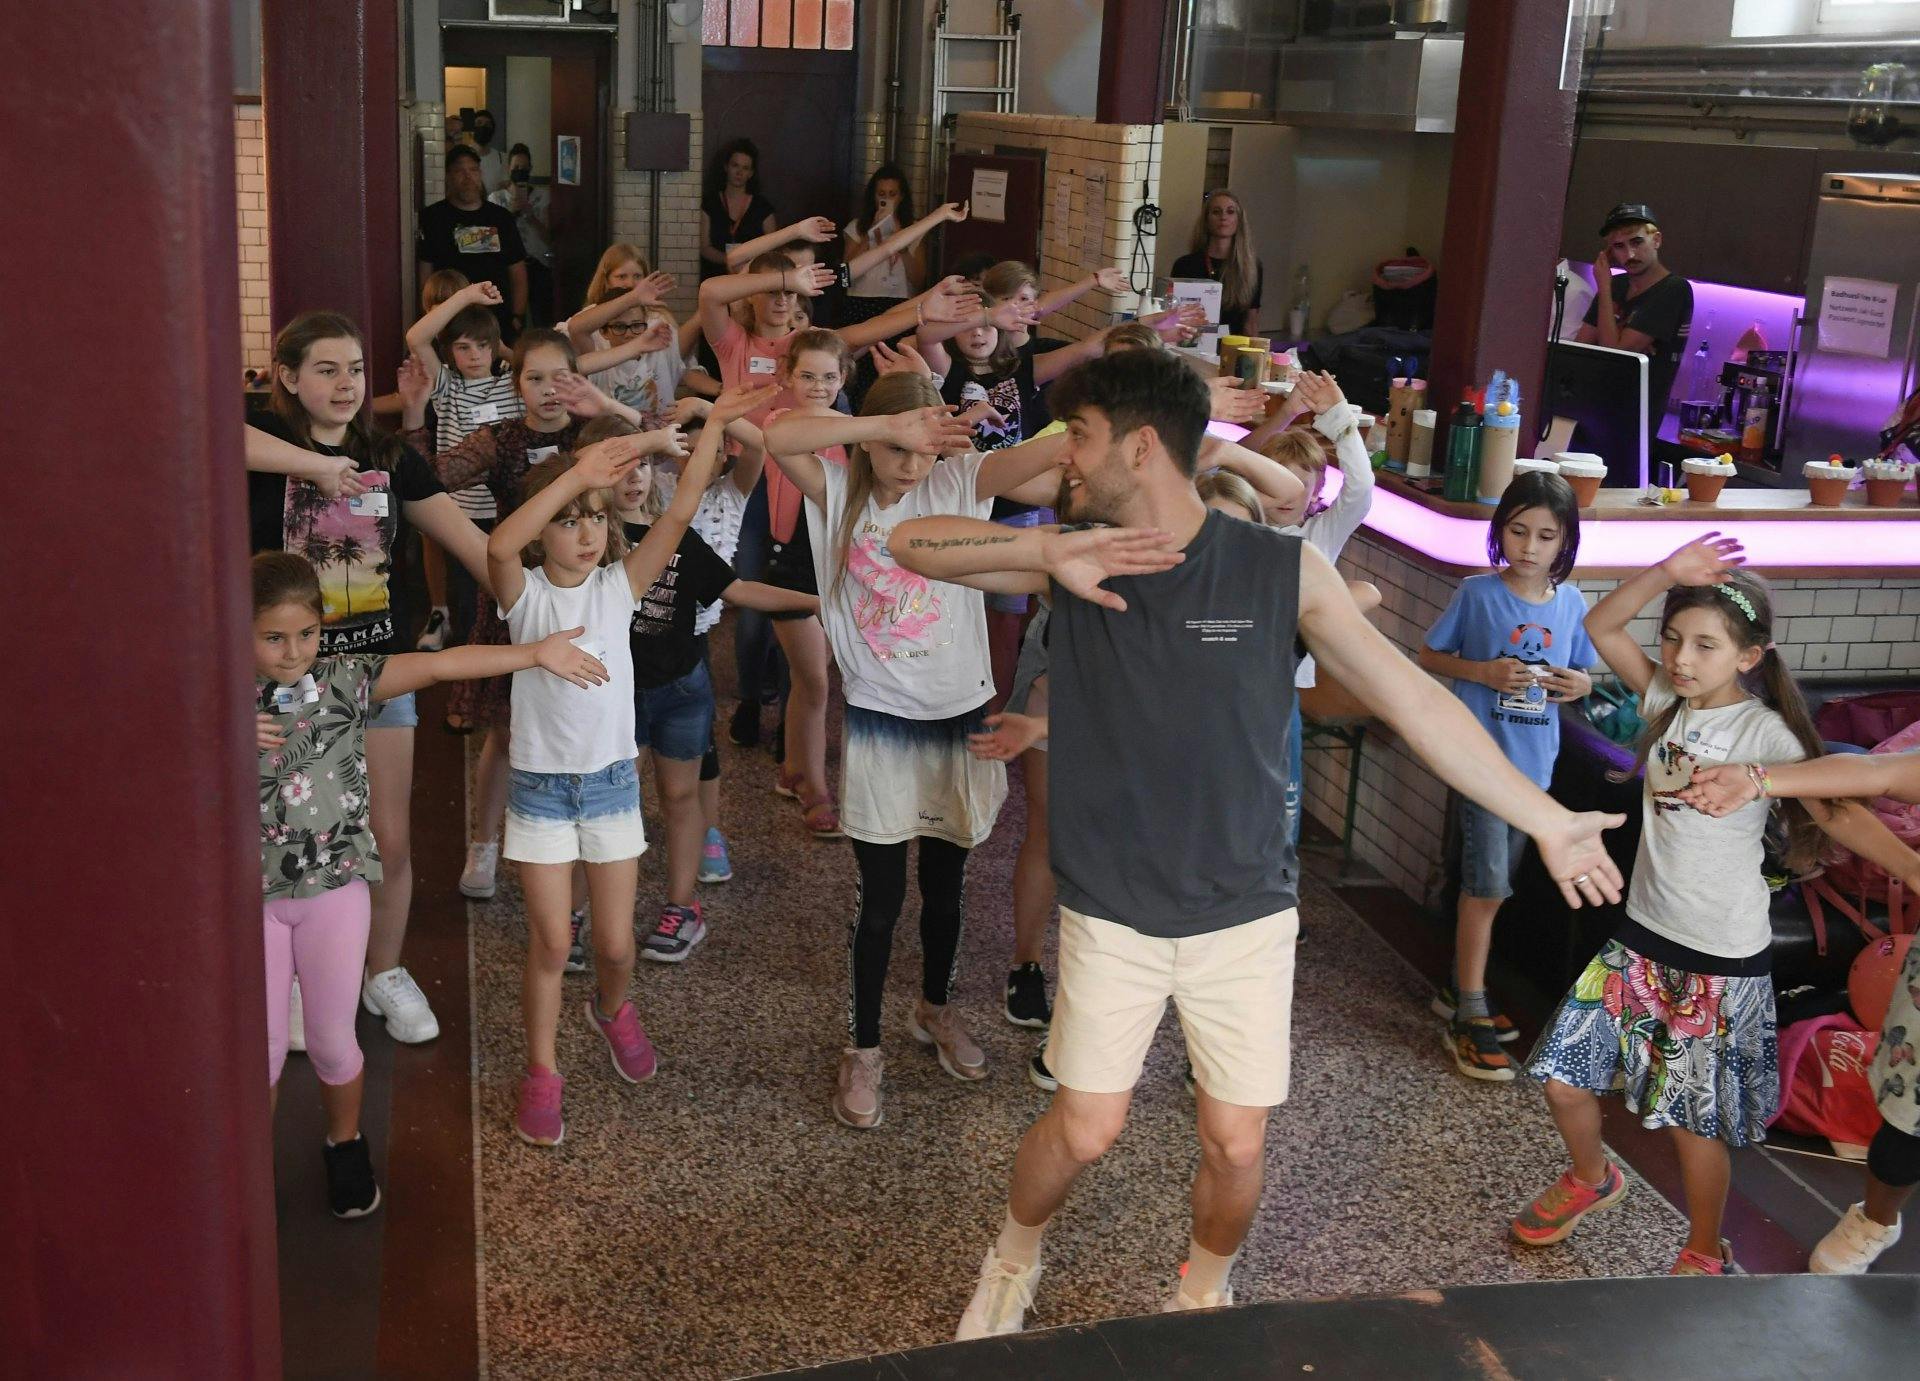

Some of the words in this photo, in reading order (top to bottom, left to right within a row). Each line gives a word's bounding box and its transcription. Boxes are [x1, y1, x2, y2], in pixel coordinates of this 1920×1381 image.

[992, 434, 1015, 450] STAR
[320, 617, 392, 645] HAMAS
[333, 640, 367, 653] SURFING
[1490, 707, 1504, 721] in
[1508, 714, 1551, 727] music
[1829, 1031, 1866, 1078] Cola
